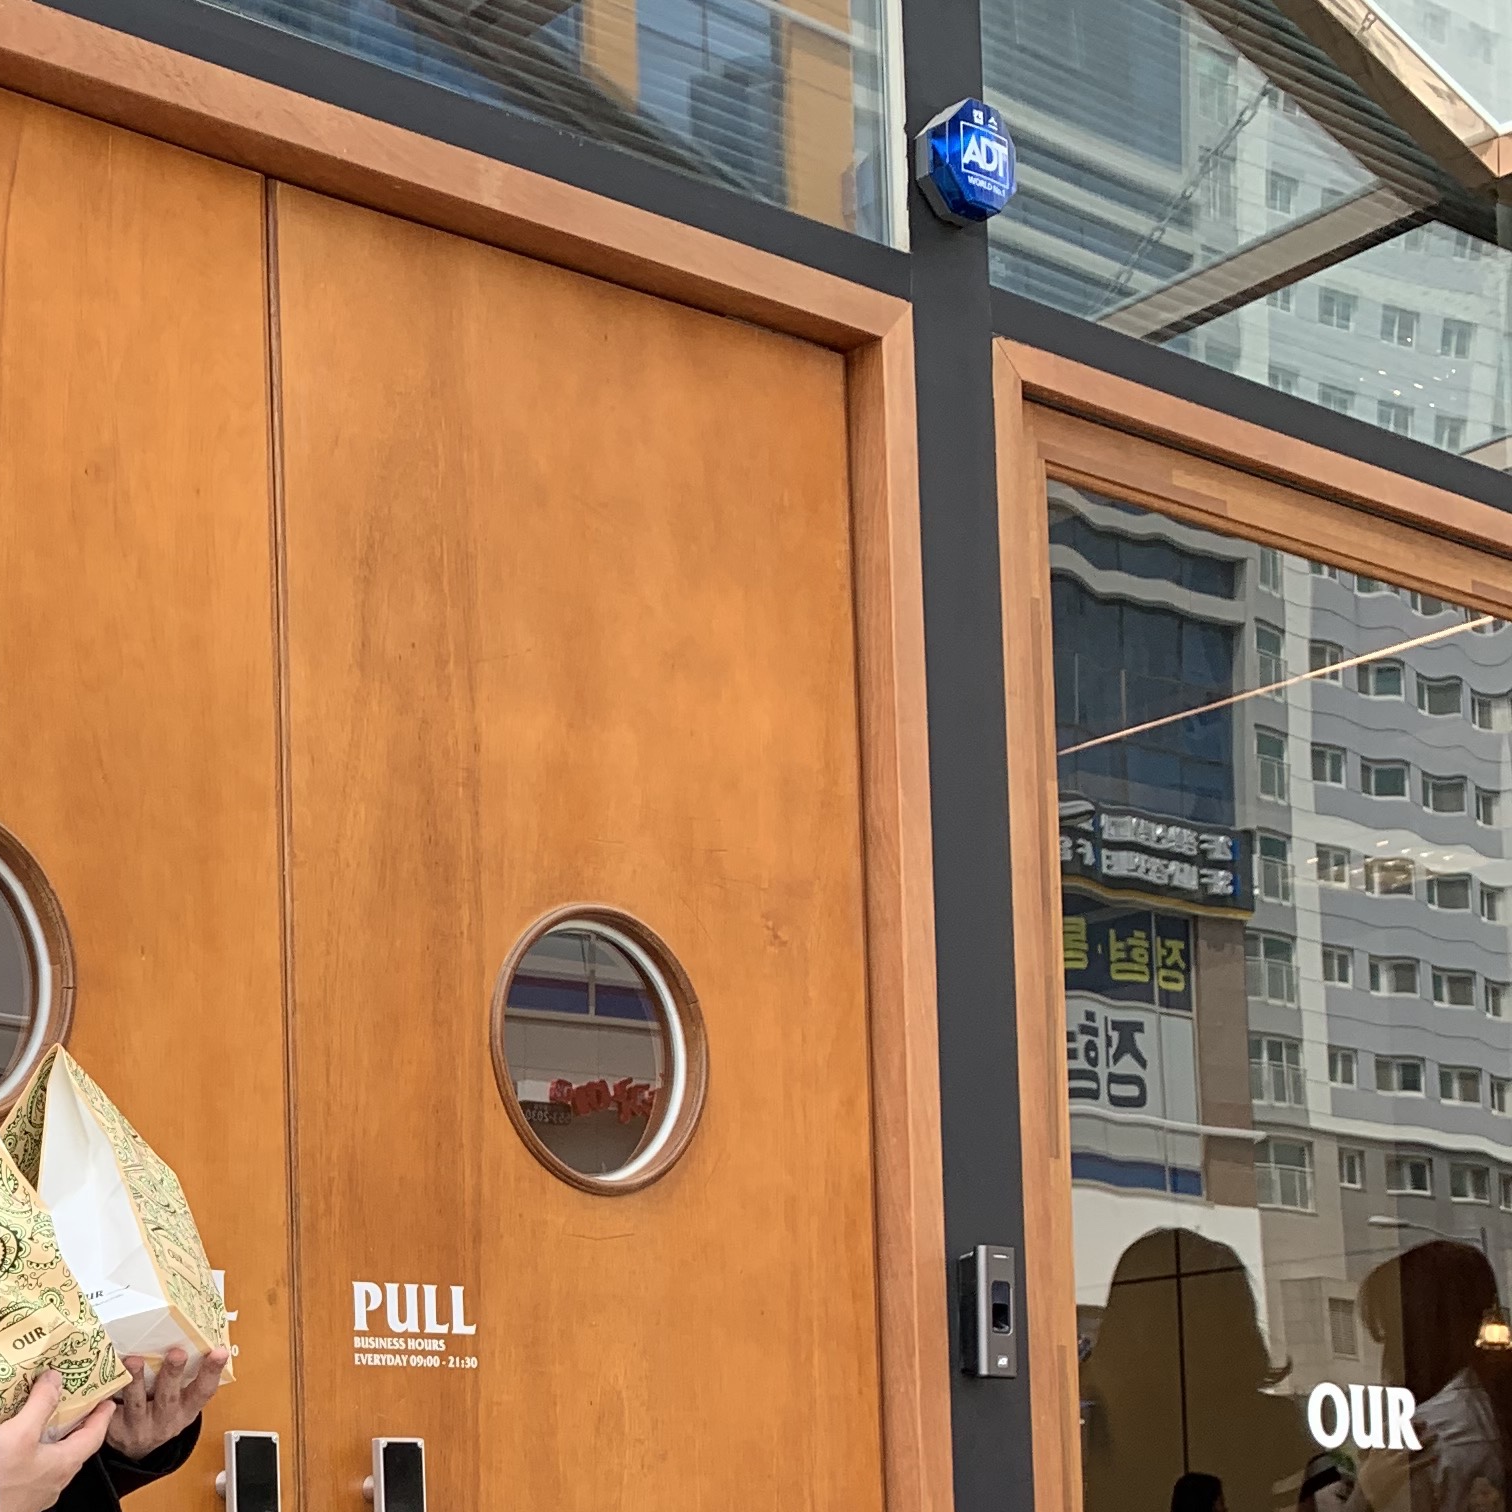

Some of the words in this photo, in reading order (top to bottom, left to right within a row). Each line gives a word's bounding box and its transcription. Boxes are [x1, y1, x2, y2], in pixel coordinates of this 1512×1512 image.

[962, 133, 1008, 177] ADT
[967, 175, 993, 191] WORLD
[352, 1281, 477, 1335] PULL
[12, 1326, 47, 1350] OUR
[354, 1337, 407, 1350] BUSINESS
[407, 1338, 446, 1351] HOURS
[354, 1353, 409, 1367] EVERYDAY
[409, 1355, 440, 1367] 09:00
[448, 1355, 478, 1369] 21:30
[1307, 1382, 1423, 1451] OUR
